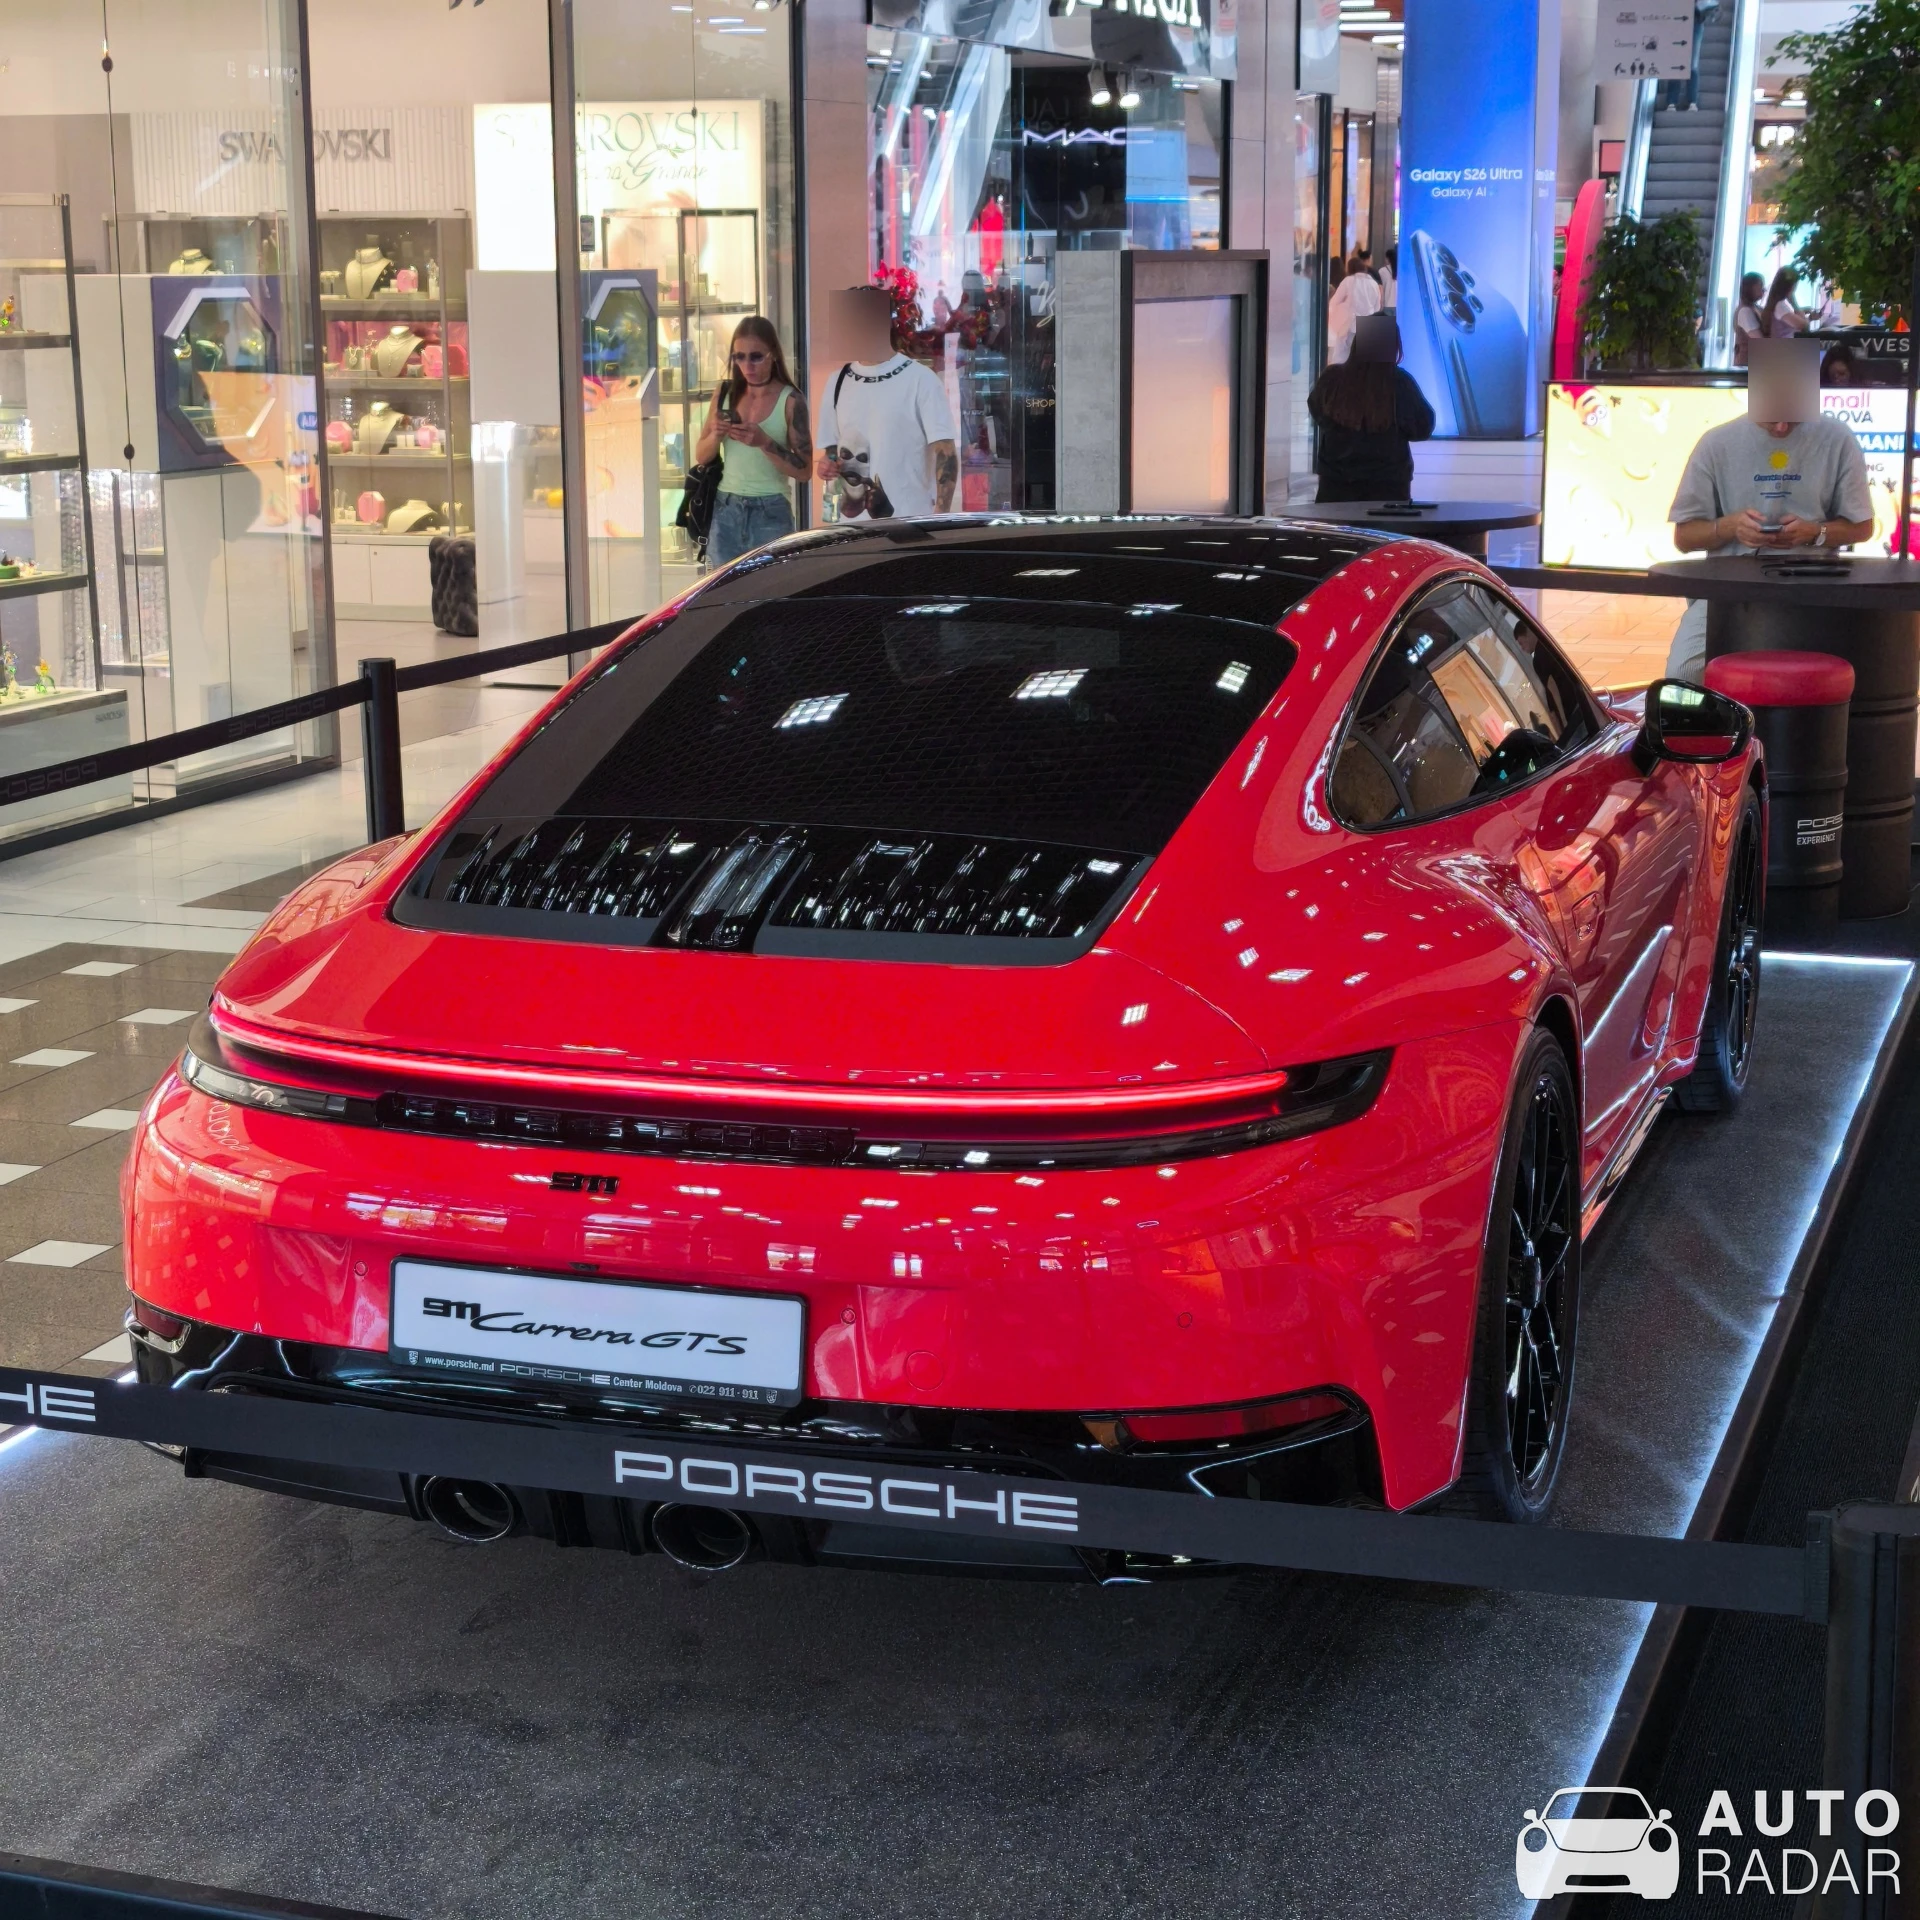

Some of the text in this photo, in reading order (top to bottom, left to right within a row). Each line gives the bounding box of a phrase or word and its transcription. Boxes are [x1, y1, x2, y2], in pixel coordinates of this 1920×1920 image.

[219, 129, 391, 163] SWAOVSKI
[1410, 169, 1461, 183] Galaxy
[1464, 169, 1487, 180] S26
[1490, 168, 1523, 180] Ultra
[1432, 187, 1487, 199] Galaxy AI
[1860, 338, 1910, 352] YVES
[845, 360, 912, 383] EVENGE
[1824, 392, 1870, 408] mall
[1856, 434, 1905, 451] MANI
[1797, 812, 1843, 829] PORS
[1796, 833, 1836, 846] EXPERIENCE
[548, 1171, 620, 1194] 911
[423, 1297, 748, 1355] 911 Carrera GTS
[425, 1355, 495, 1372] www.porsche.md
[500, 1363, 611, 1385] PORSCHE
[613, 1376, 643, 1390] Center
[645, 1379, 683, 1393] Moldova
[697, 1384, 716, 1396] 022
[0, 1383, 96, 1422] HE
[614, 1450, 1078, 1532] PORSCHE
